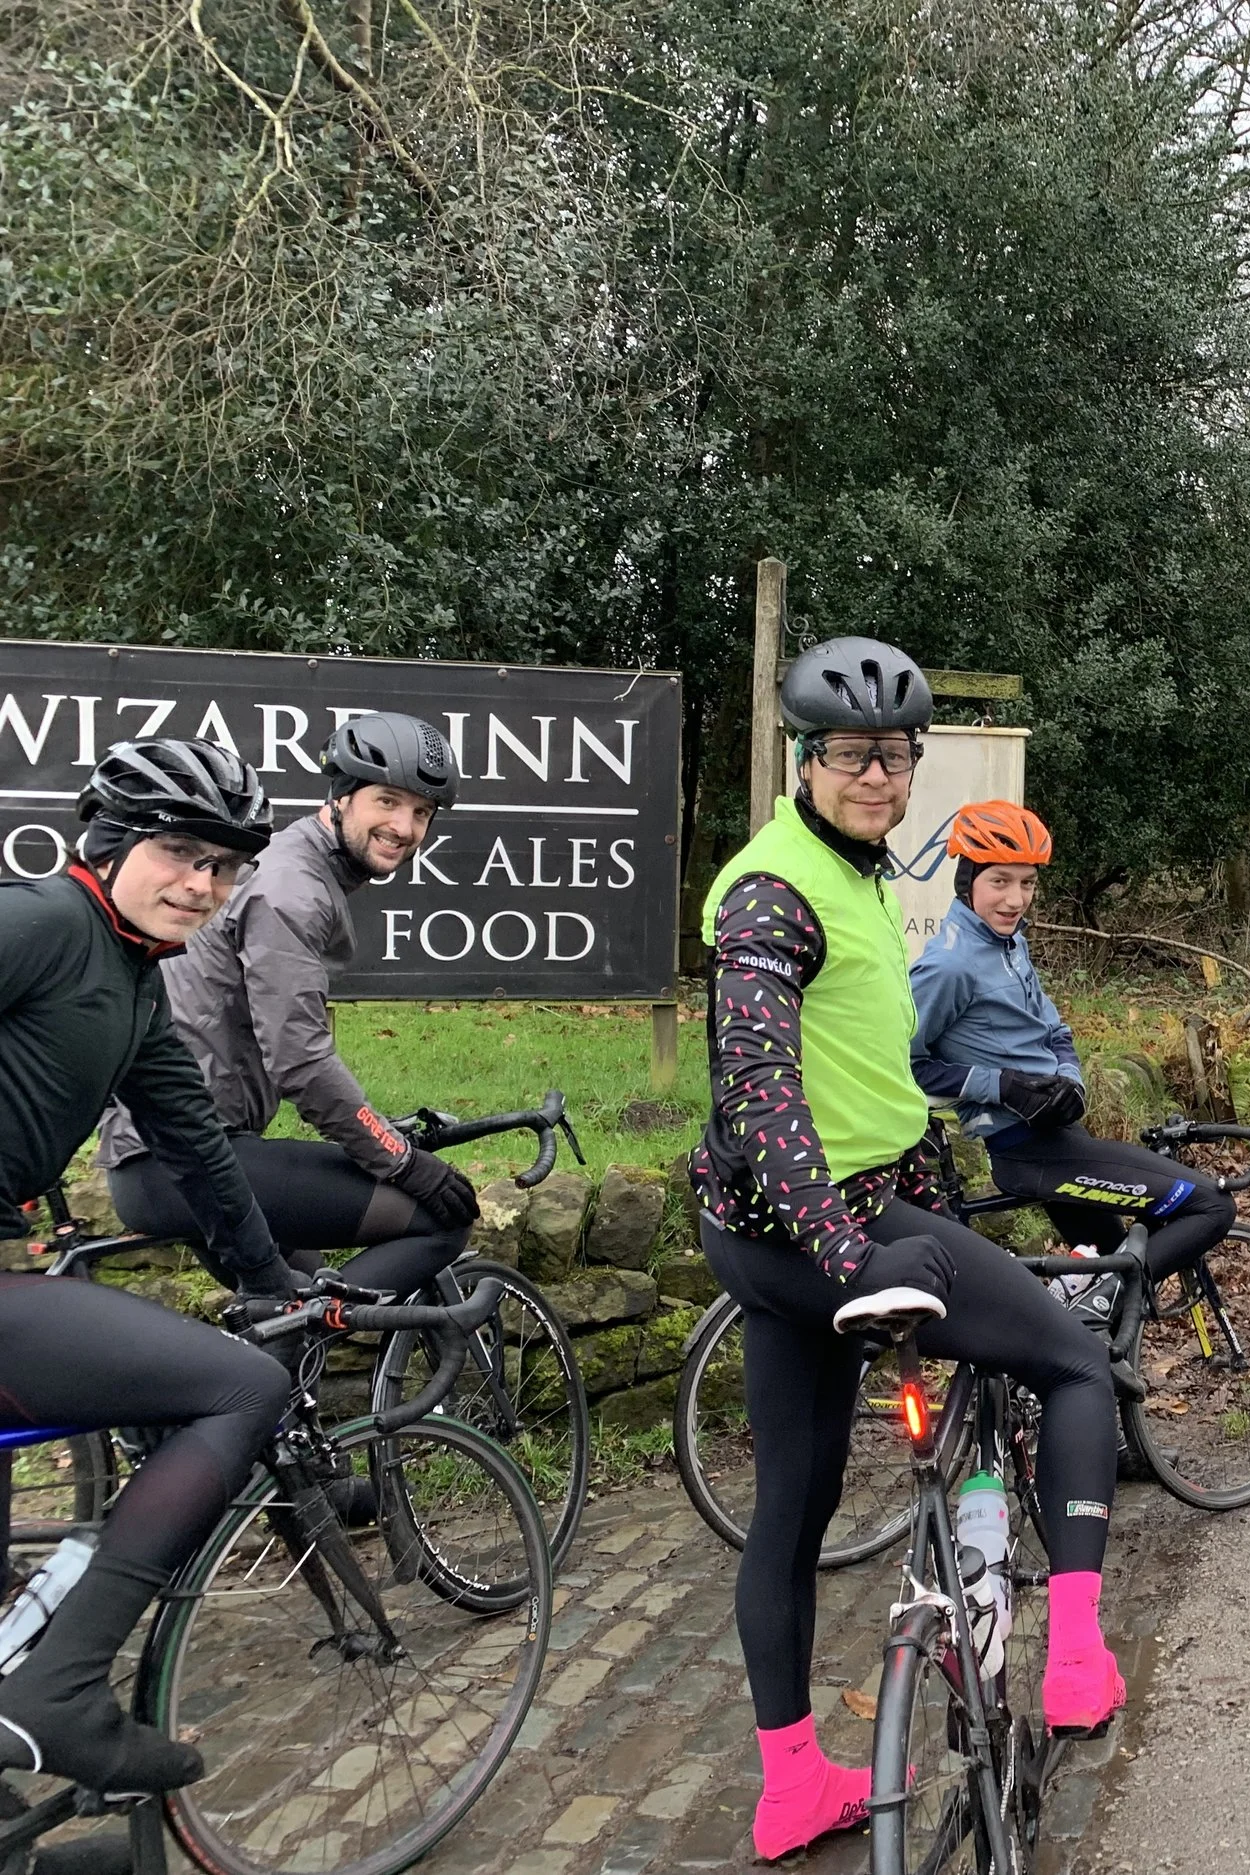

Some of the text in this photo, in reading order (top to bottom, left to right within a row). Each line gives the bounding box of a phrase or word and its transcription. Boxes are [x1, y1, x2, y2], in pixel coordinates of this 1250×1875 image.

[0, 693, 639, 785] WIZAR INN
[473, 837, 635, 889] ALES
[381, 909, 596, 962] FOOD
[1055, 1183, 1138, 1207] PLANET
